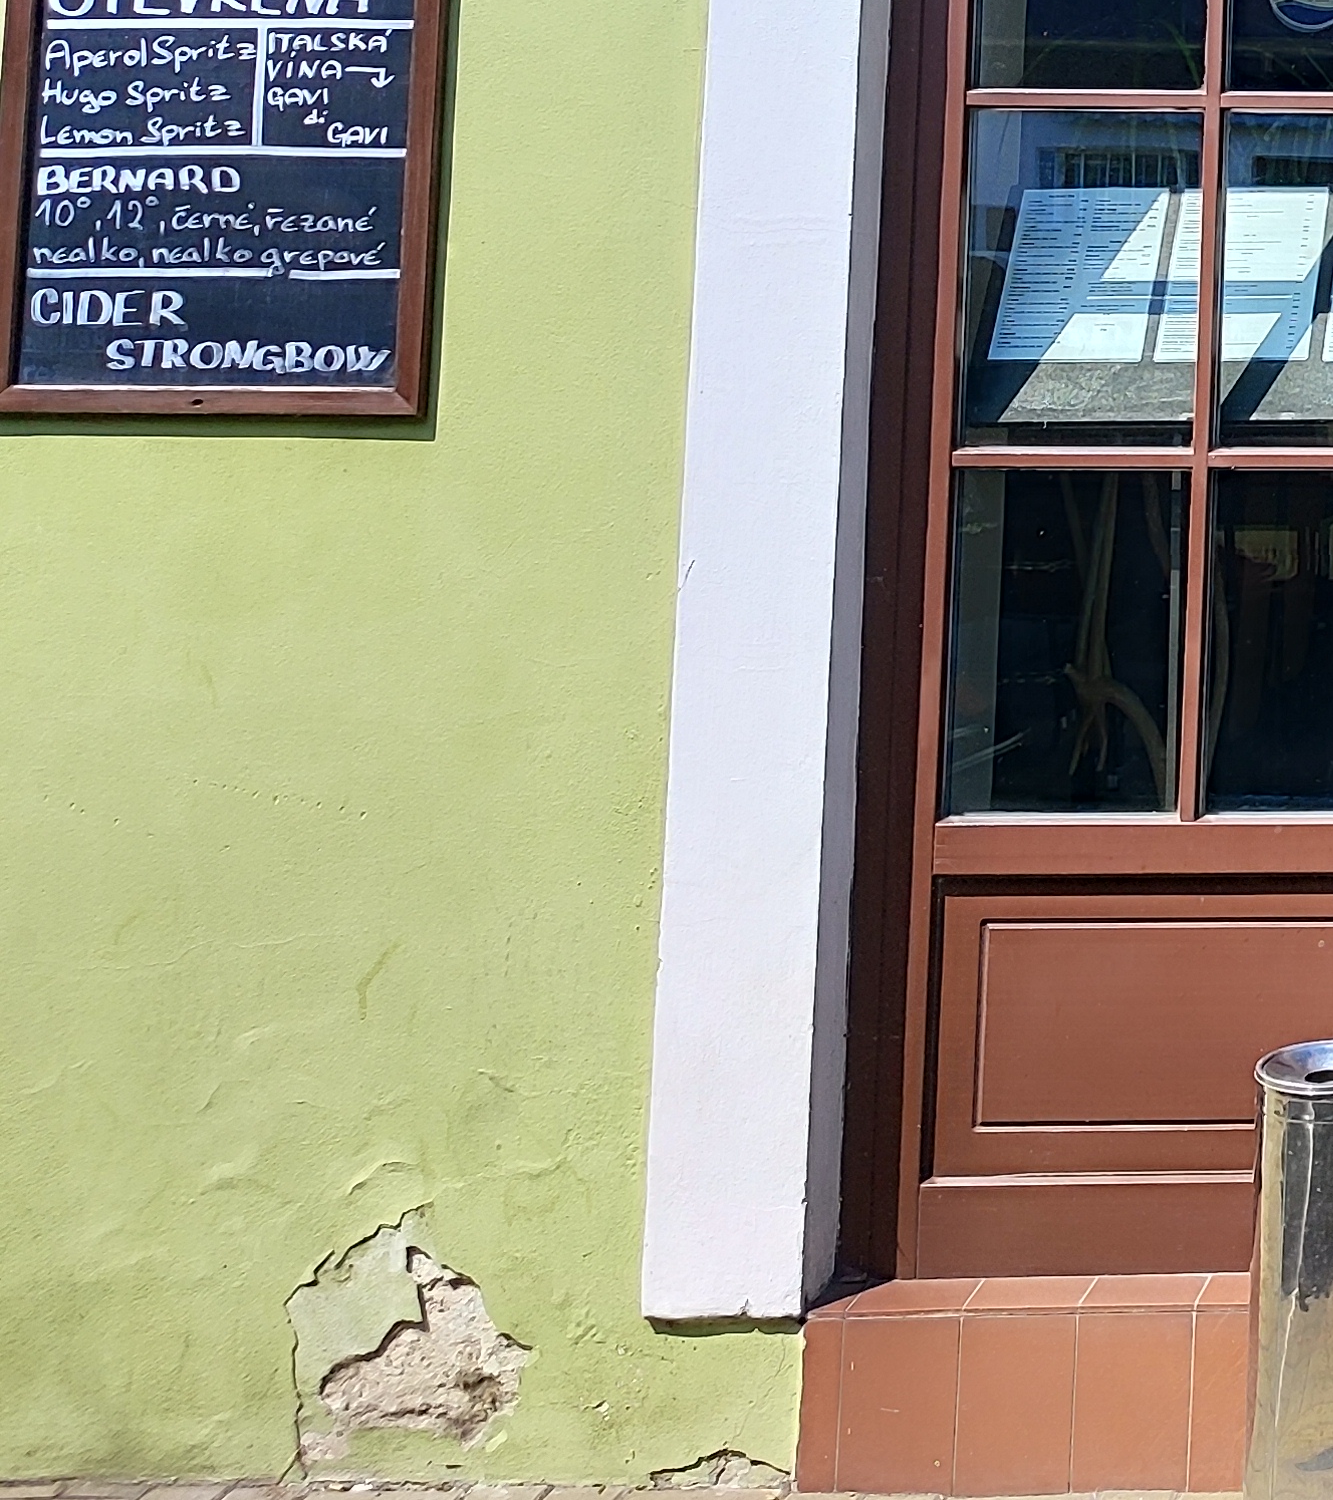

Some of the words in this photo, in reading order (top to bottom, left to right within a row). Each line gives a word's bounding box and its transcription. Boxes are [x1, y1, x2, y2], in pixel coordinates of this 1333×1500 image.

[44, 37, 147, 77] Aperol
[151, 35, 258, 73] Spritz
[267, 28, 393, 54] ITALSKÁ
[266, 52, 343, 82] VÍNA
[42, 77, 118, 113] Hugo
[125, 77, 232, 113] Spritz
[266, 86, 329, 109] GAVI
[39, 117, 134, 145] Lemon
[139, 114, 247, 145] Spritz
[302, 107, 329, 126] di
[326, 122, 389, 147] GAVI
[36, 164, 242, 195] BERNARD
[33, 236, 145, 268] nealko,
[152, 235, 253, 264] nealko
[258, 240, 386, 277] grepové
[30, 287, 189, 331] CIDER
[105, 337, 392, 374] STRONGBOW
